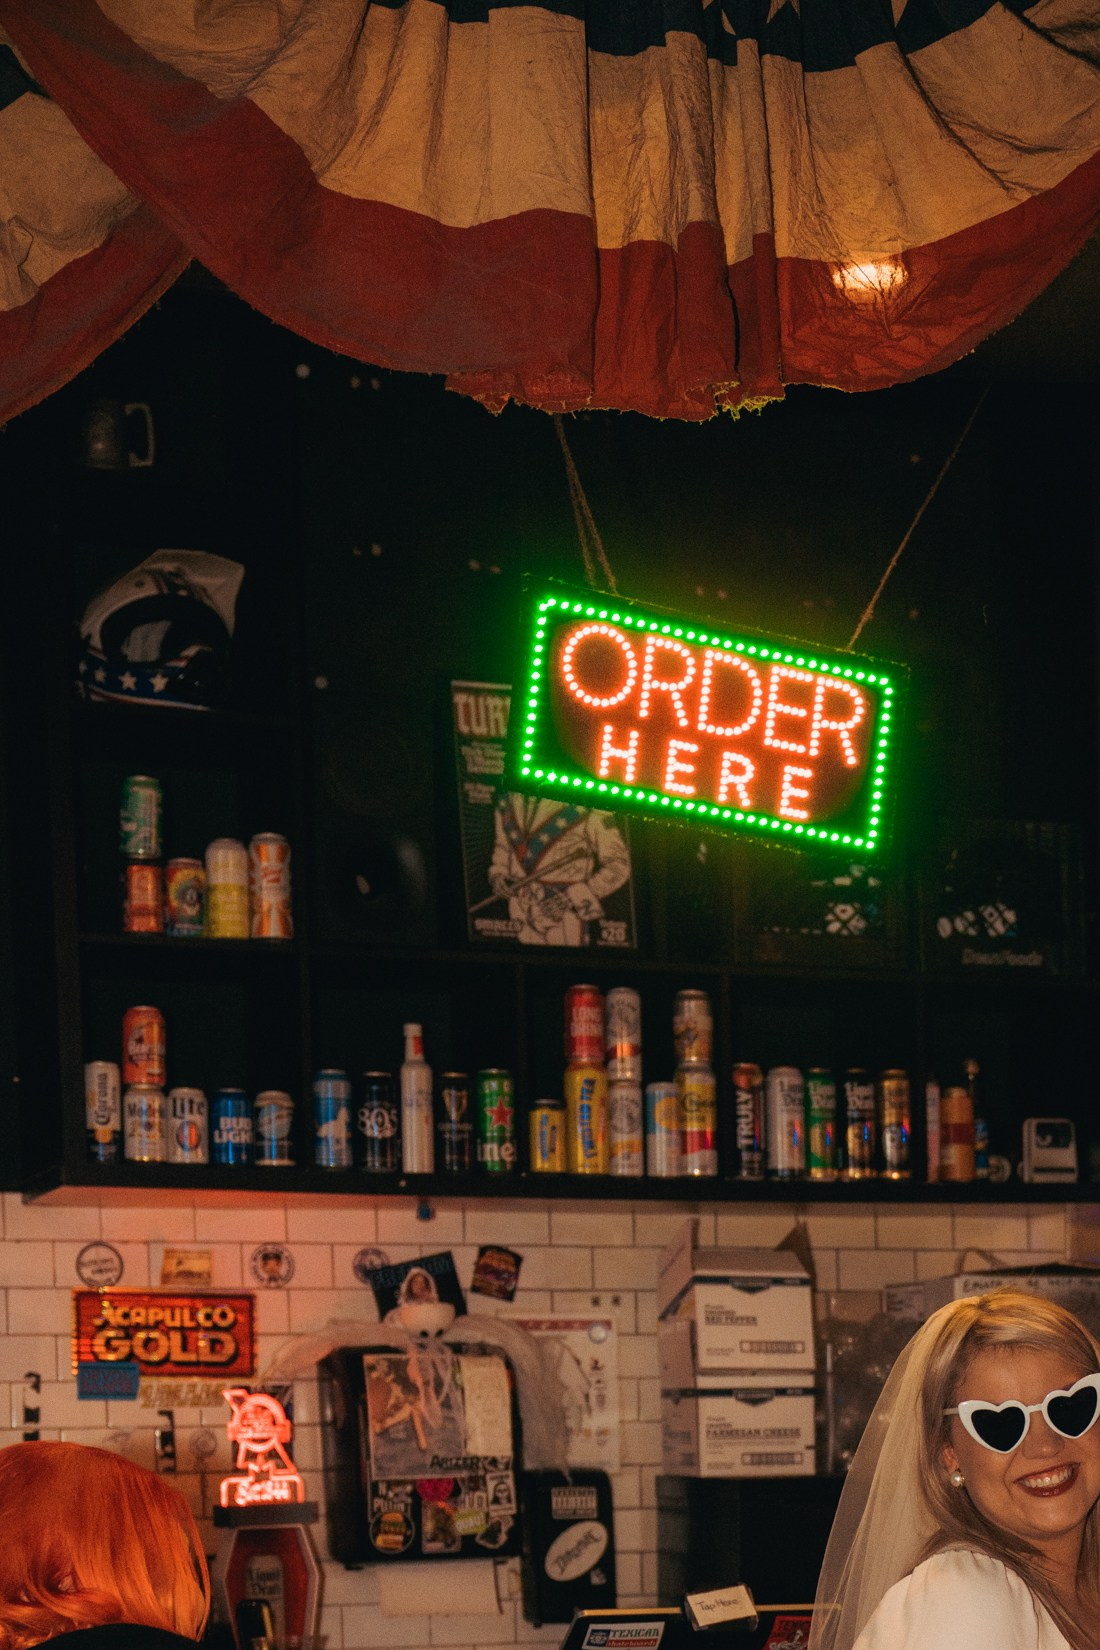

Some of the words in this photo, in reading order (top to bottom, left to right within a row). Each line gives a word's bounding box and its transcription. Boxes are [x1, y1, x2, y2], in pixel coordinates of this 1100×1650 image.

[560, 622, 866, 768] ORDER
[598, 722, 814, 821] HERE
[91, 1329, 238, 1364] GOLD
[706, 1427, 761, 1438] PARMESAN
[763, 1427, 801, 1437] CHEESE
[698, 1600, 717, 1612] Tap
